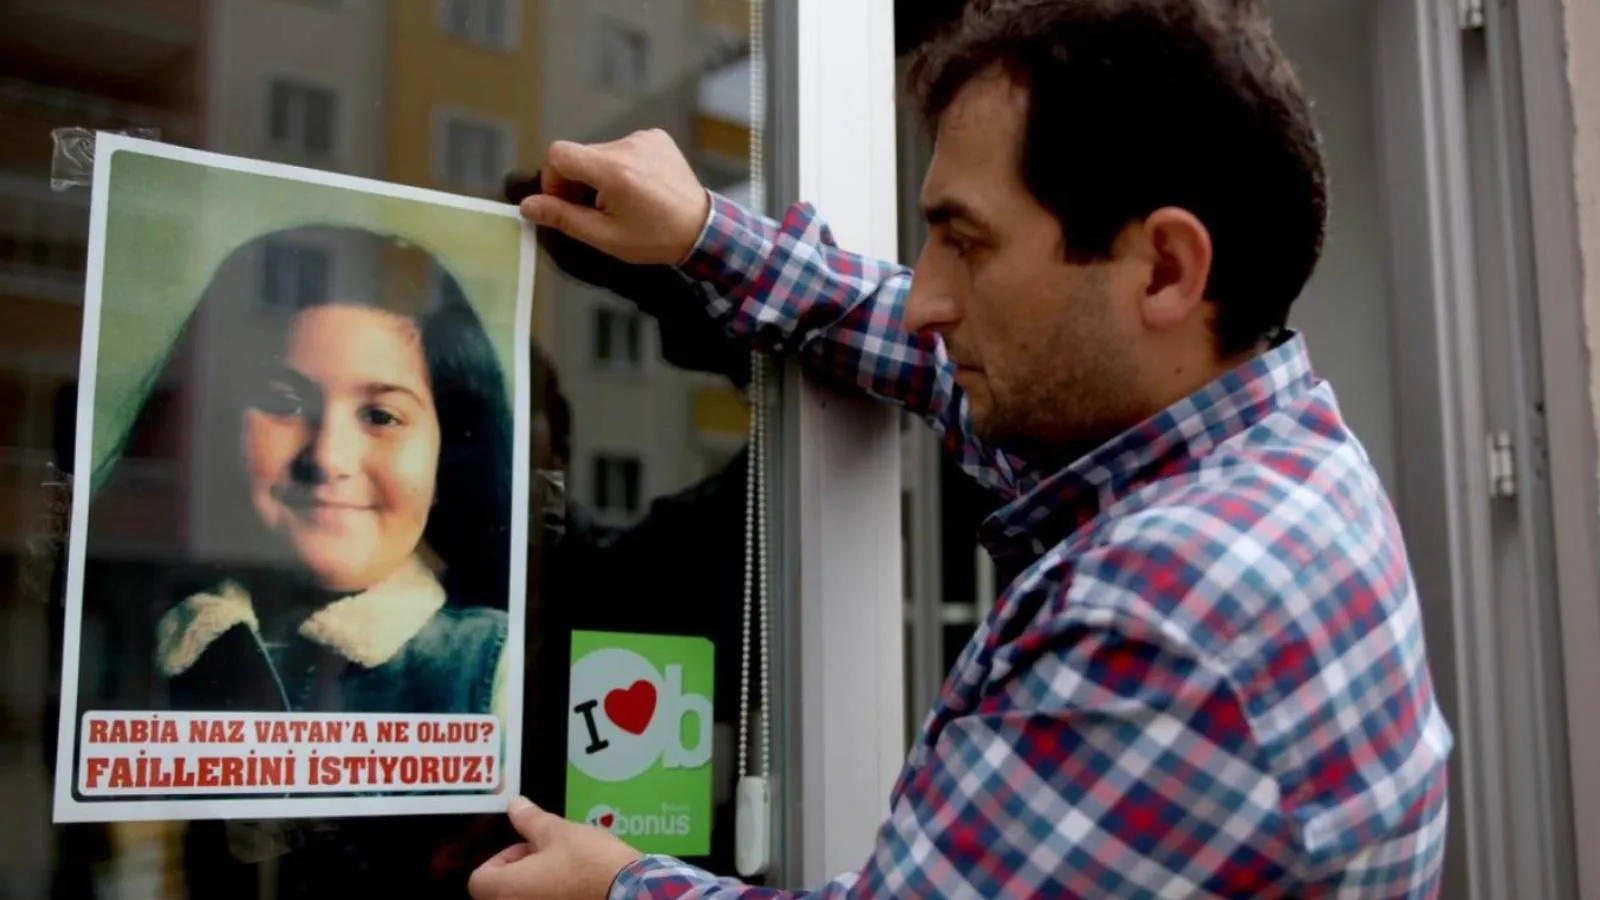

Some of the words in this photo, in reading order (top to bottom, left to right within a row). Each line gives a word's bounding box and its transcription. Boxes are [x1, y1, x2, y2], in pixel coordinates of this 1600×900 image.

[88, 714, 179, 743] RABİA
[188, 719, 245, 743] NAZ
[254, 720, 369, 743] VATAN'A
[376, 721, 410, 743] NE
[416, 721, 495, 743] OLDU?
[573, 699, 609, 755] I
[85, 749, 297, 788] FAİLLERİNİ
[308, 749, 495, 785] İSTİYORUZ!
